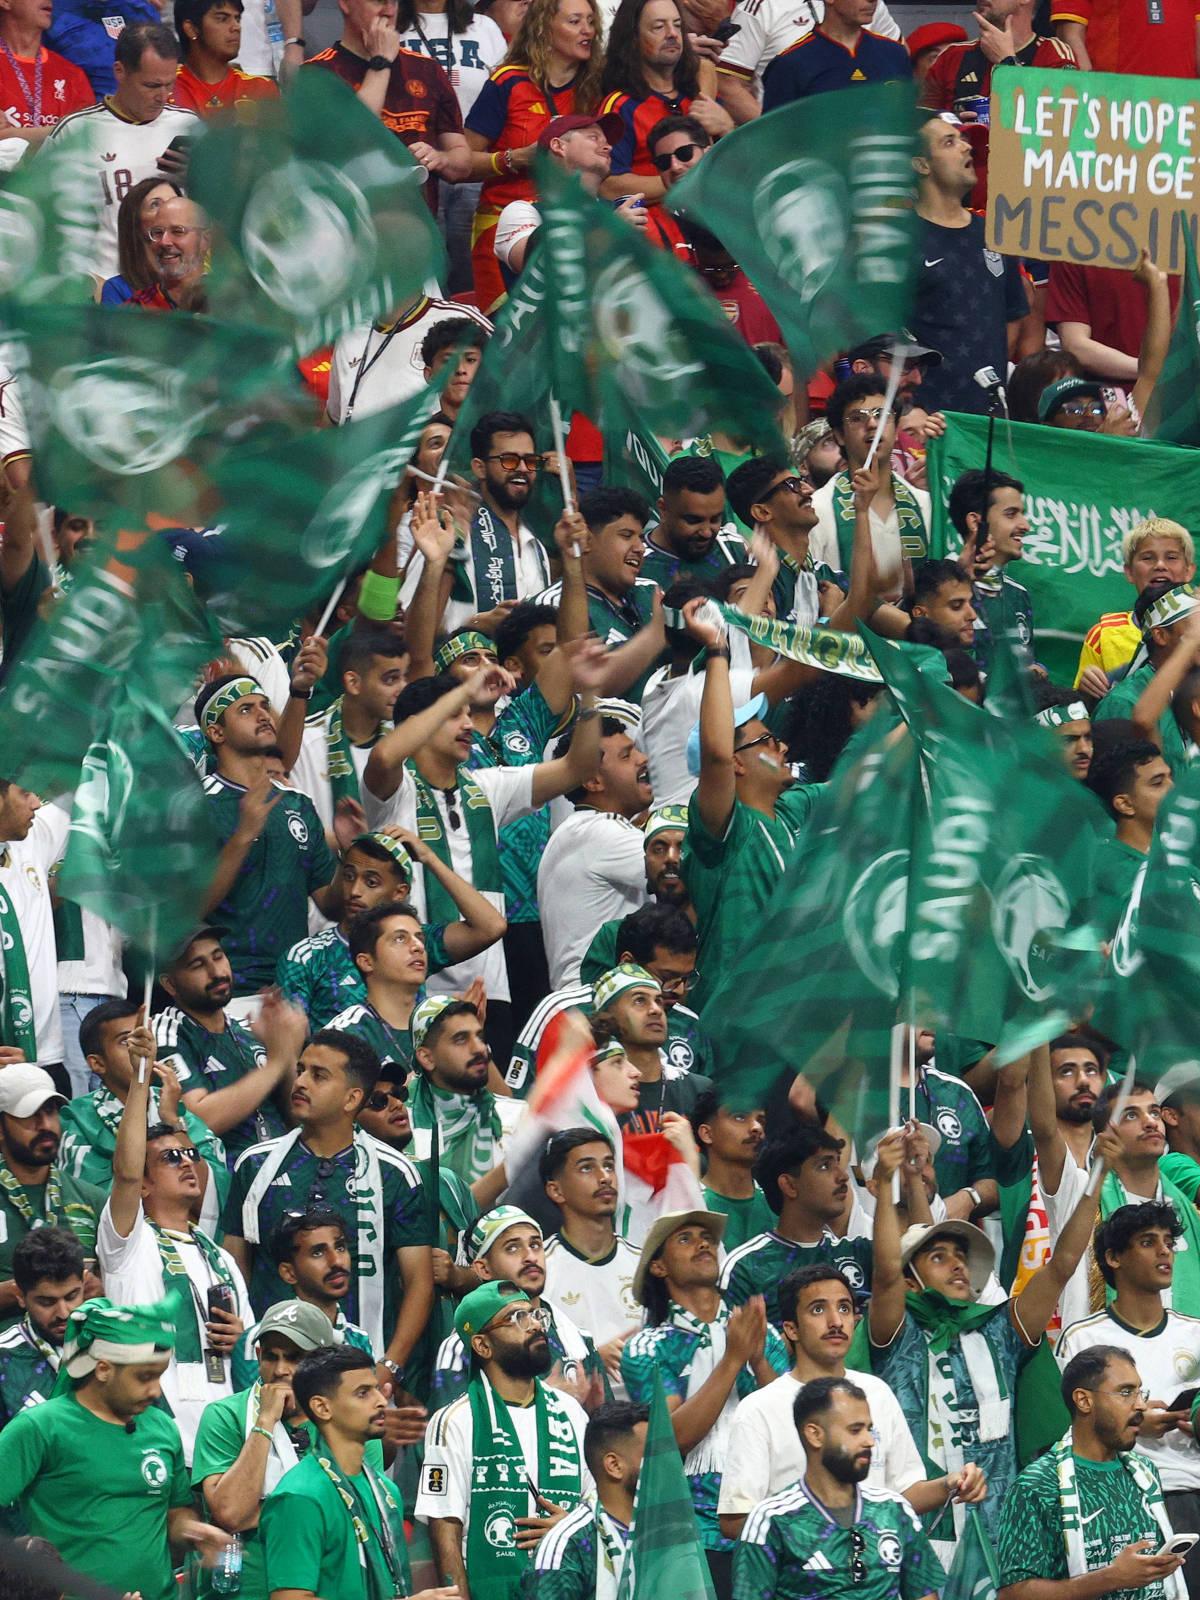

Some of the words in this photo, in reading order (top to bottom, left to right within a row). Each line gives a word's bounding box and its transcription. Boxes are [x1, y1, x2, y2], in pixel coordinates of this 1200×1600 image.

[1015, 92, 1101, 139] LET'S
[1110, 101, 1195, 147] HOPE
[1024, 148, 1137, 194] MATCH
[909, 795, 994, 962] SAUDI
